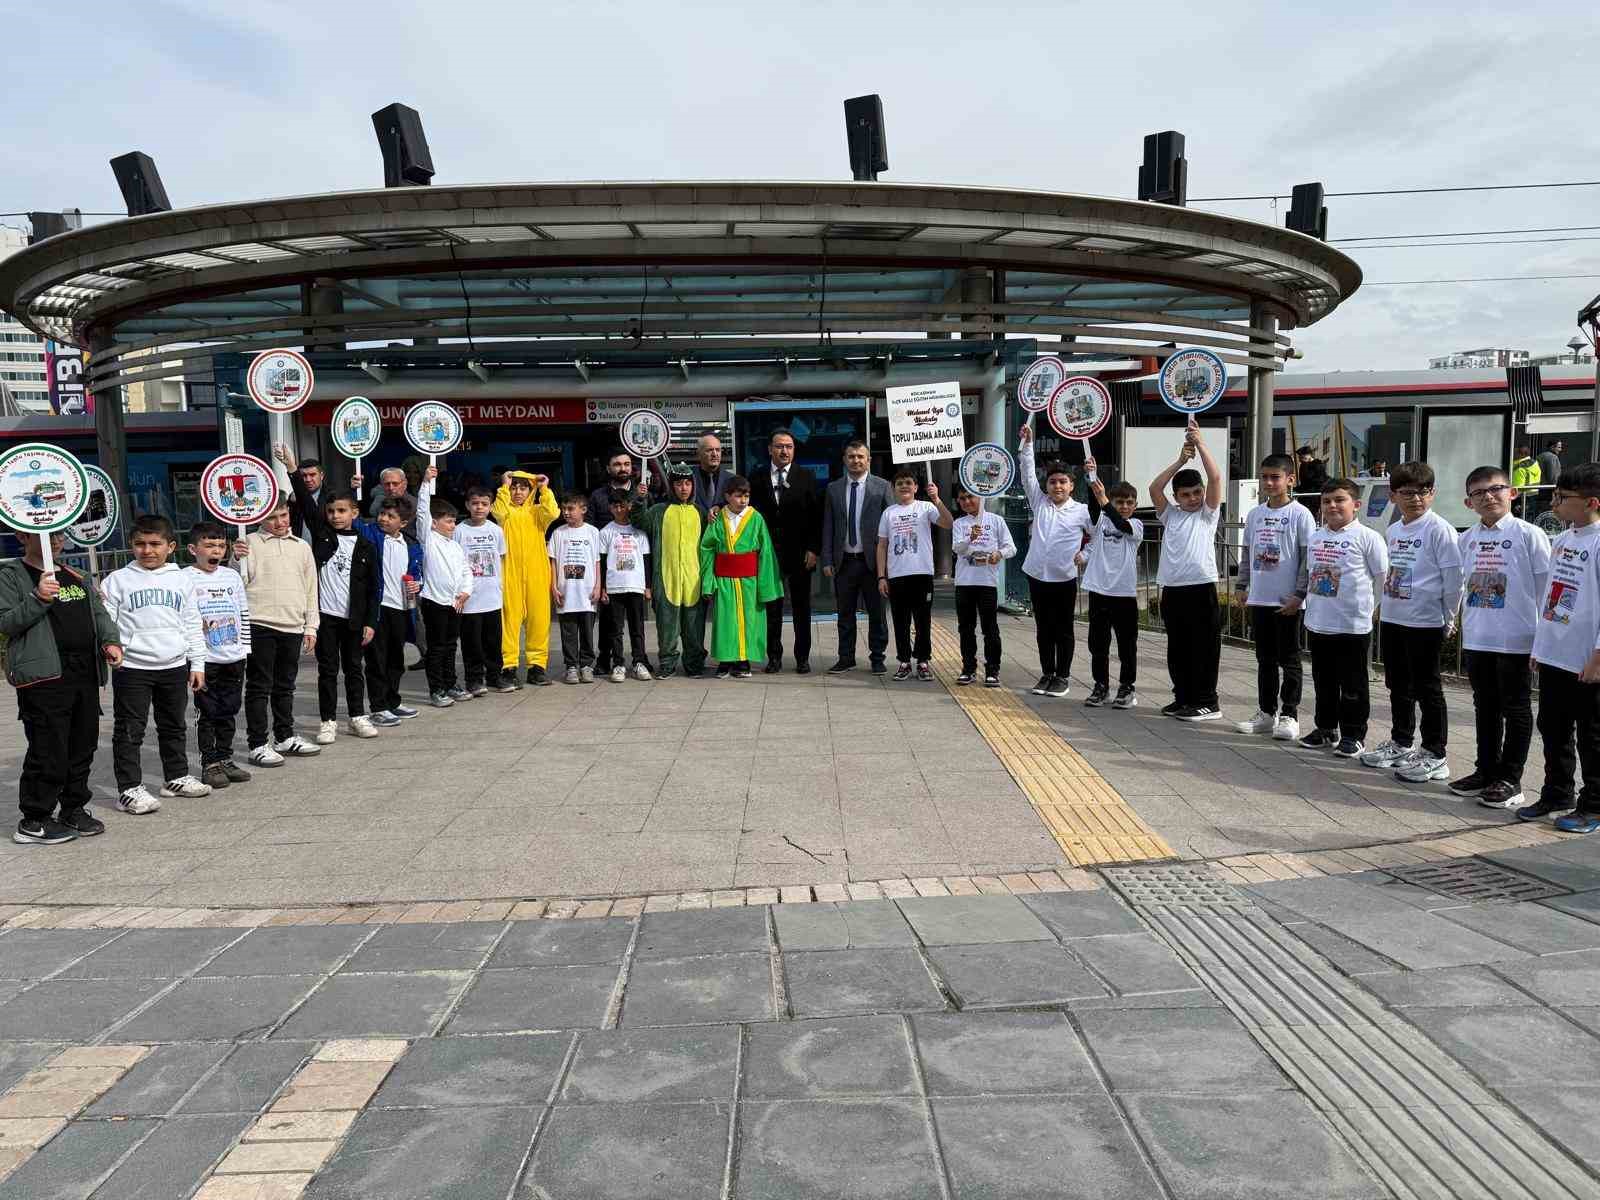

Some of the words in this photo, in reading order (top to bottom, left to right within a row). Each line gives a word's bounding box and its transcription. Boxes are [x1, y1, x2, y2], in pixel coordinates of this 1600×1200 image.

[480, 405, 555, 418] MEYDANI
[892, 433, 911, 443] TOPLU
[912, 430, 933, 442] TAŞIMA
[934, 428, 962, 440] ARAÇLARI
[906, 447, 935, 457] KULLANIM
[936, 443, 953, 454] ADABI
[128, 589, 182, 613] JORDAN
